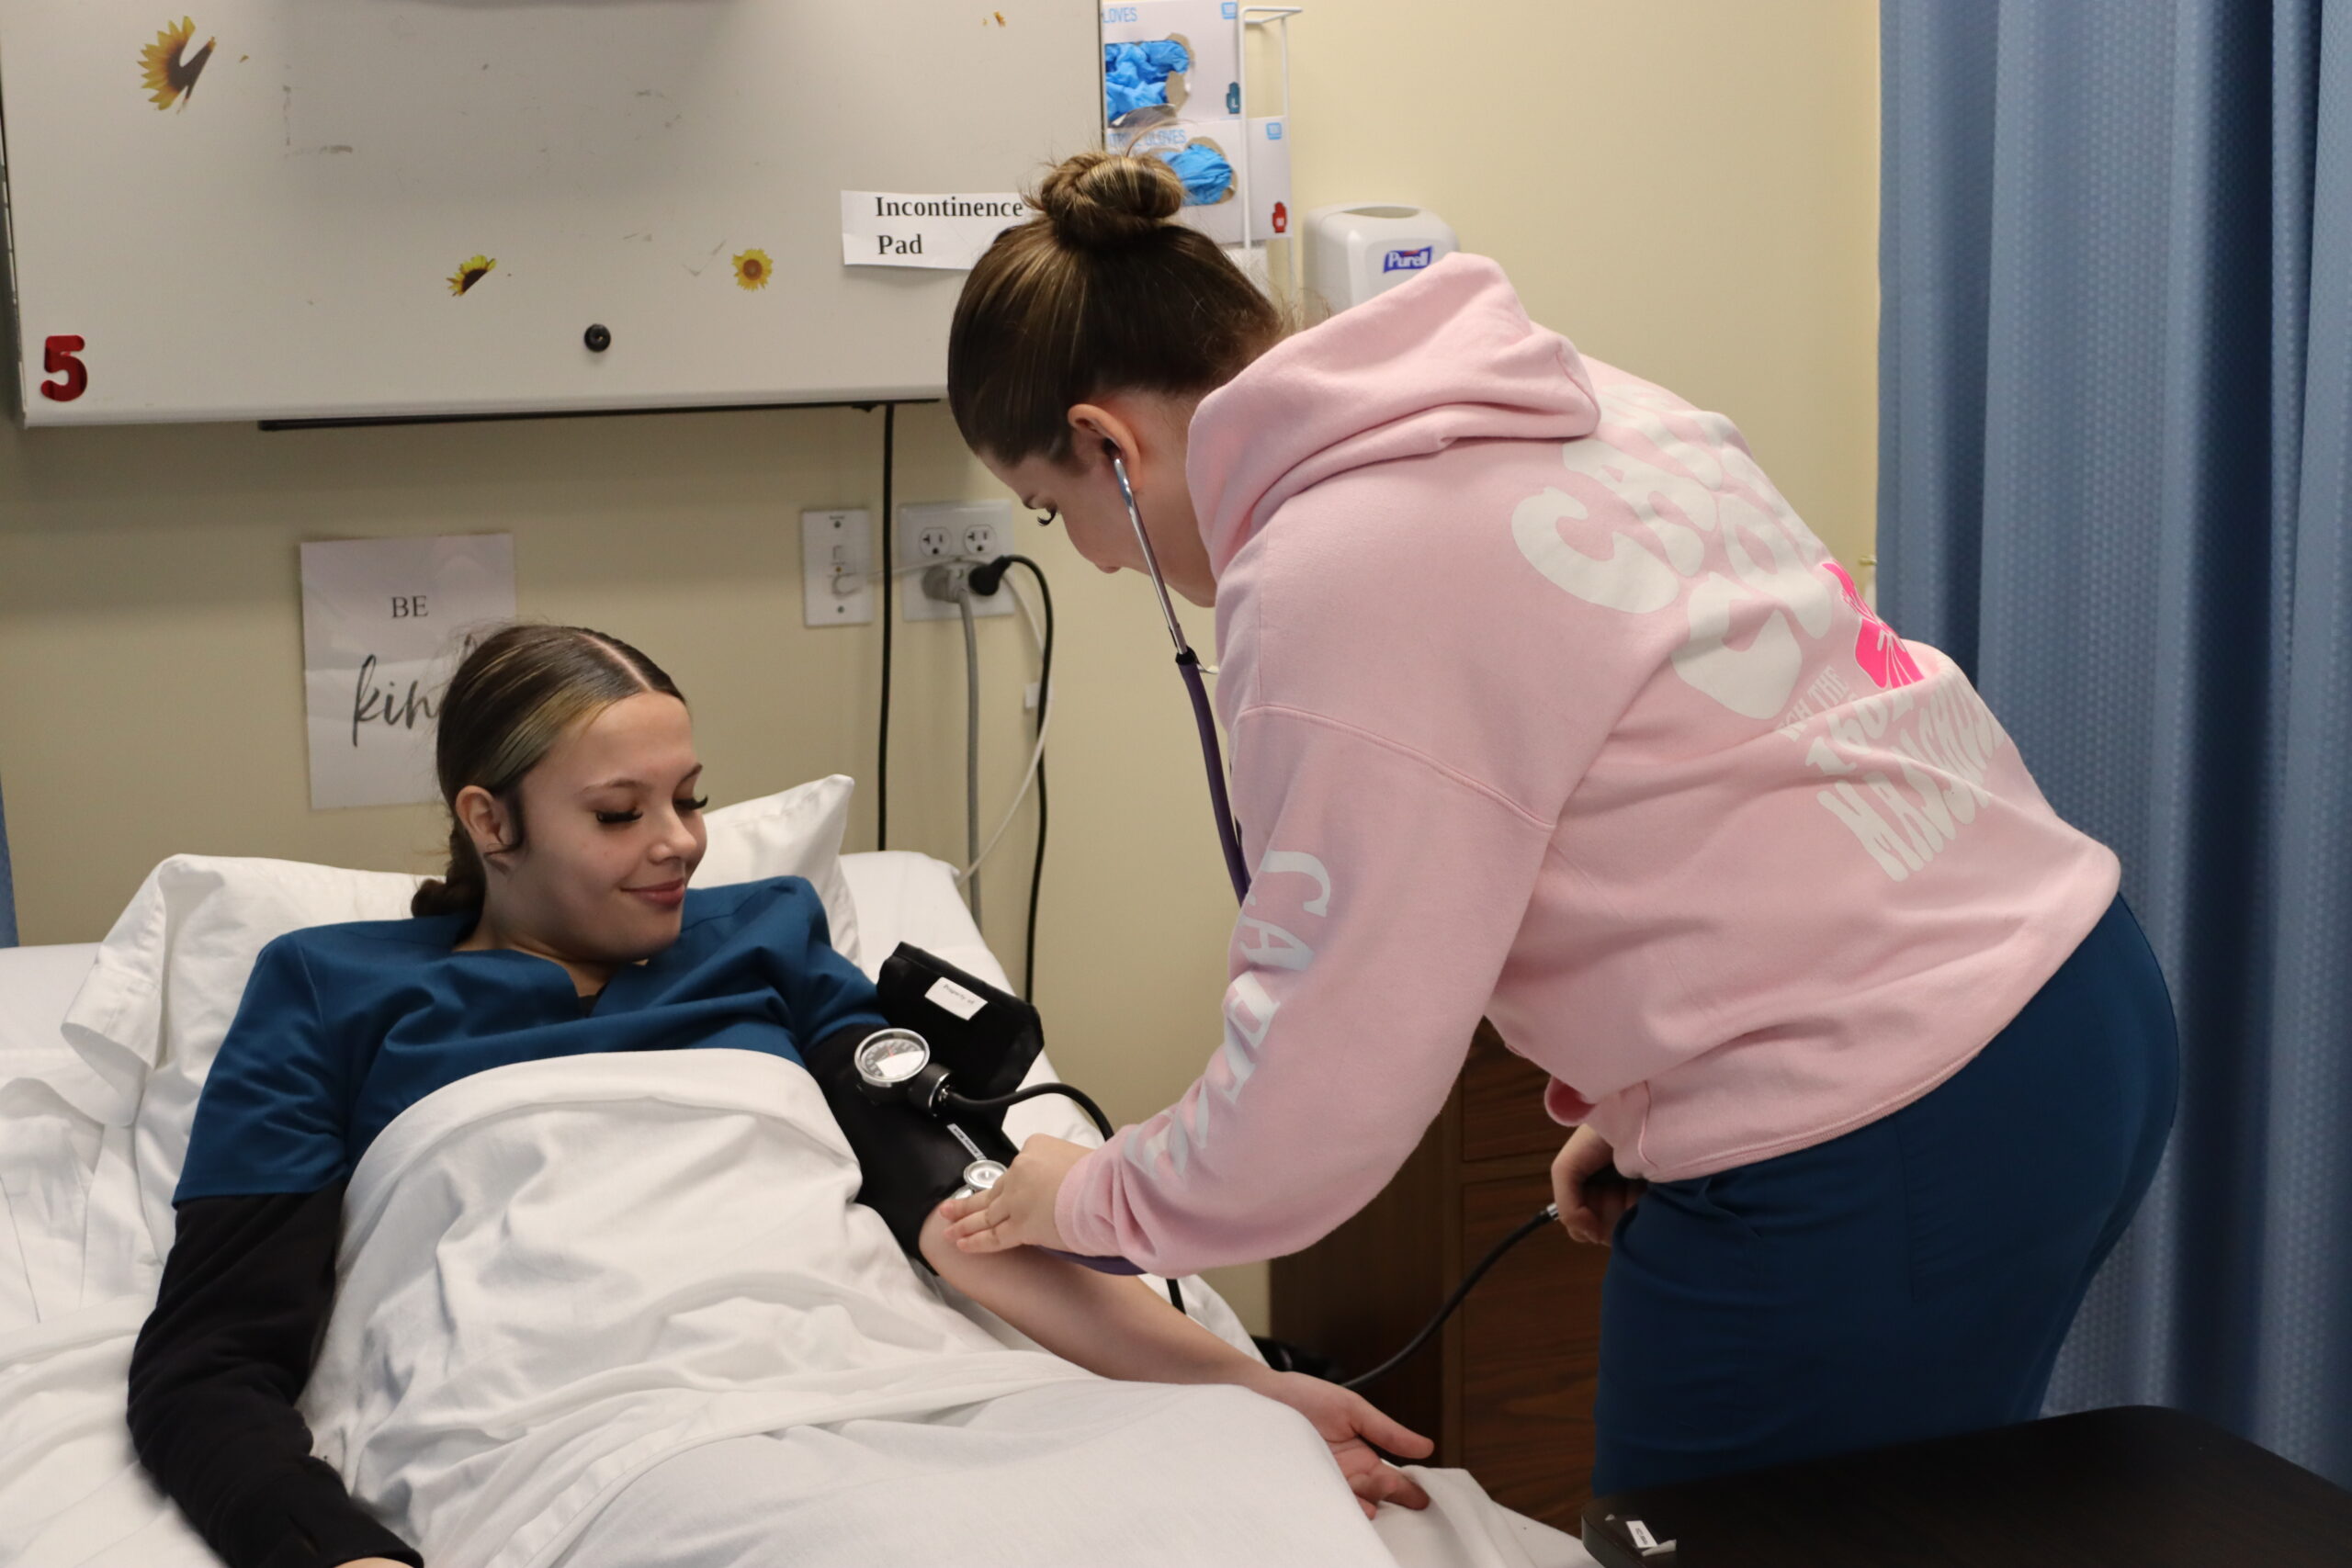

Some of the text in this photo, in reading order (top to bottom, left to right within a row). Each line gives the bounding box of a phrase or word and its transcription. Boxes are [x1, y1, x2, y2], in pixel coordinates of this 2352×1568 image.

[1102, 7, 1138, 24] LOVES
[875, 196, 1023, 217] Incontinence
[877, 233, 923, 255] Pad
[40, 334, 88, 402] 5
[391, 595, 429, 618] BE
